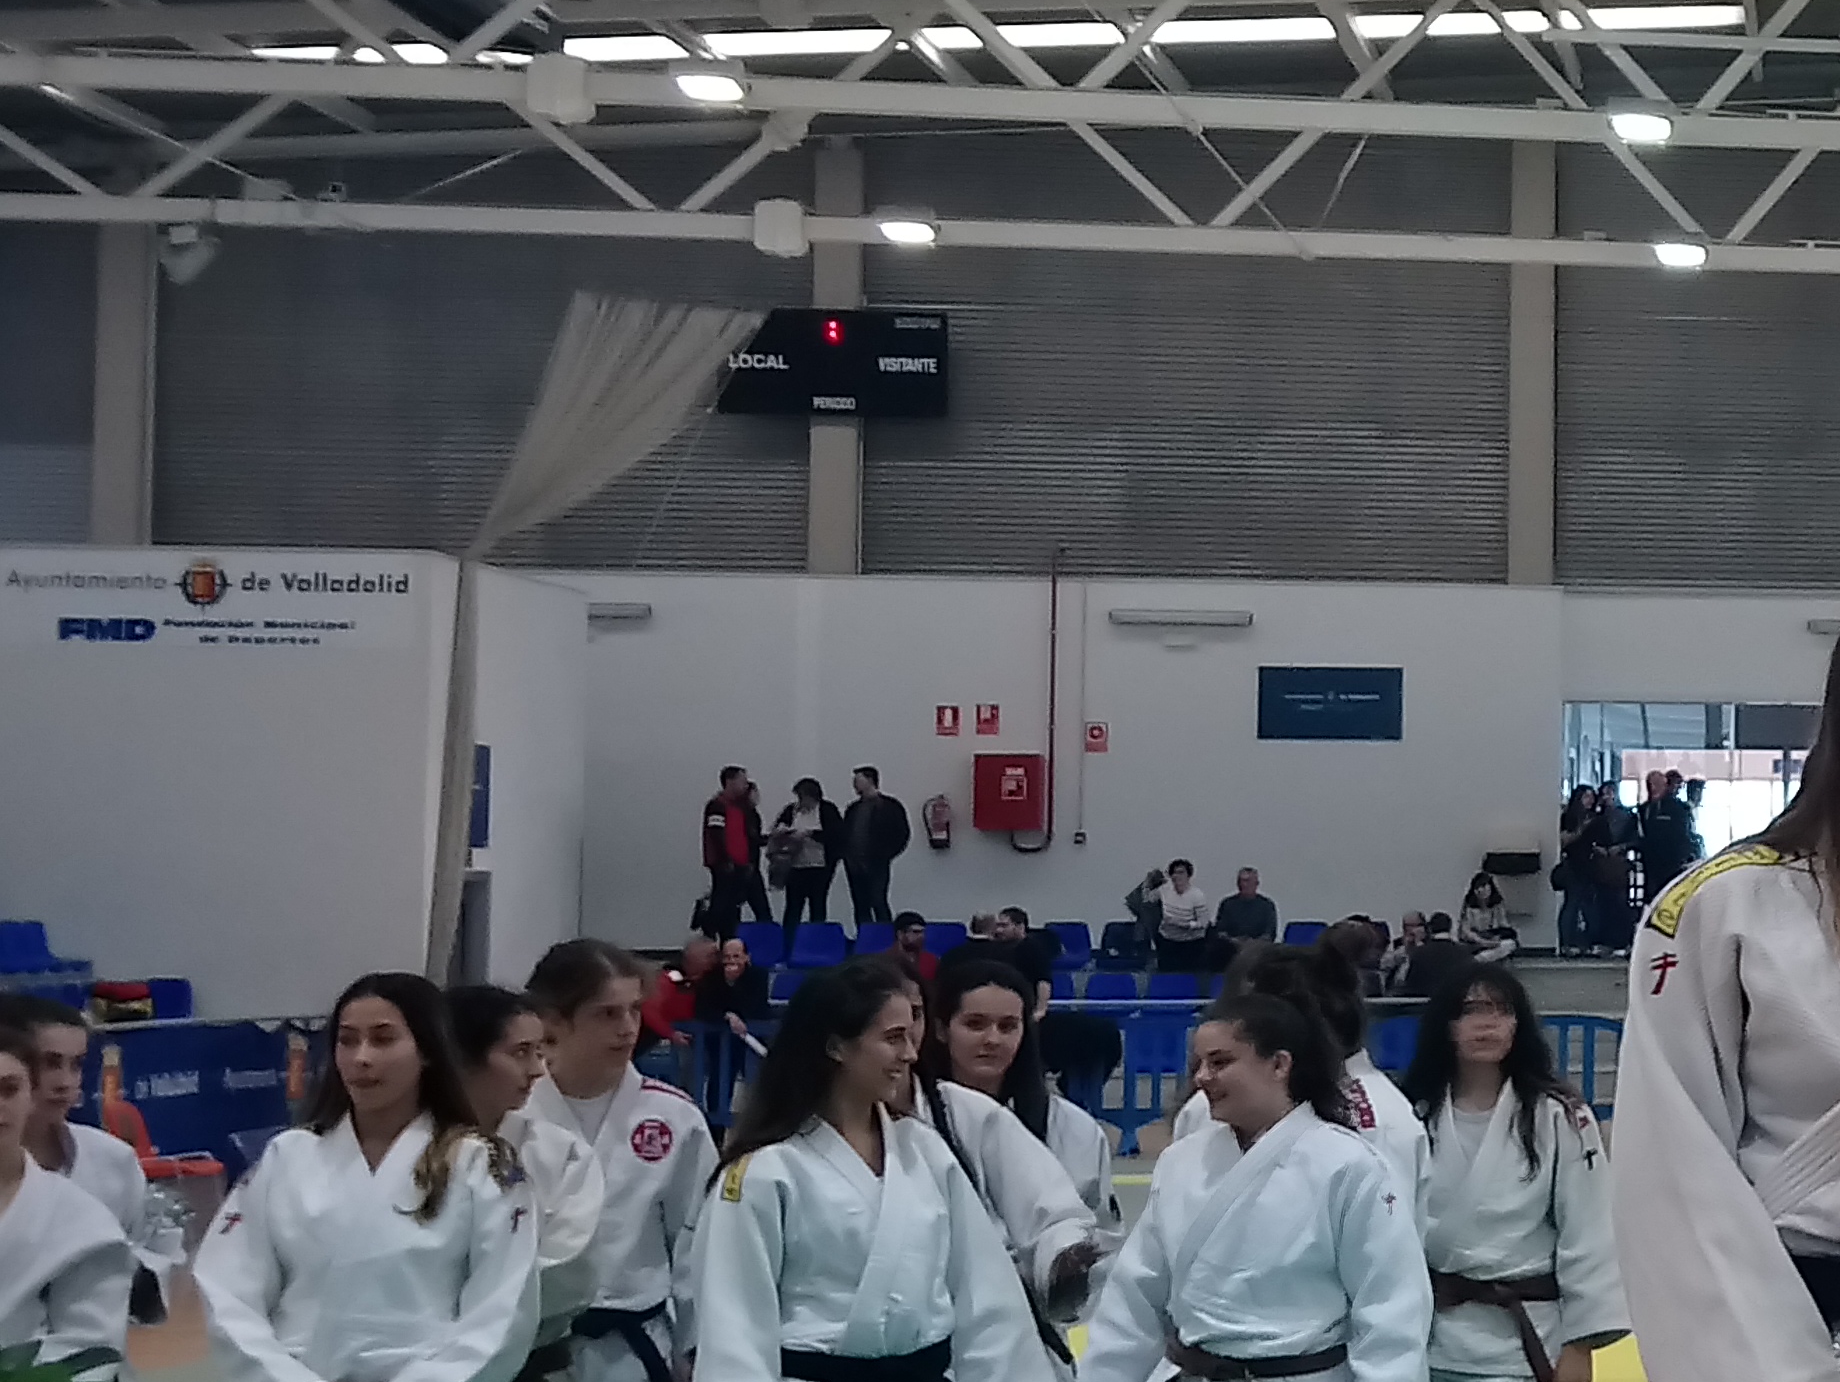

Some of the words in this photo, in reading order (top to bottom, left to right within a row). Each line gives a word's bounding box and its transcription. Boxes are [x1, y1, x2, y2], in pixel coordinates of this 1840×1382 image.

[728, 353, 790, 370] LOCAL
[878, 356, 938, 374] VISITANTE
[5, 569, 168, 594] Ayuntamiento
[240, 572, 271, 592] de
[281, 573, 410, 595] Valladolid
[57, 617, 157, 642] FMD
